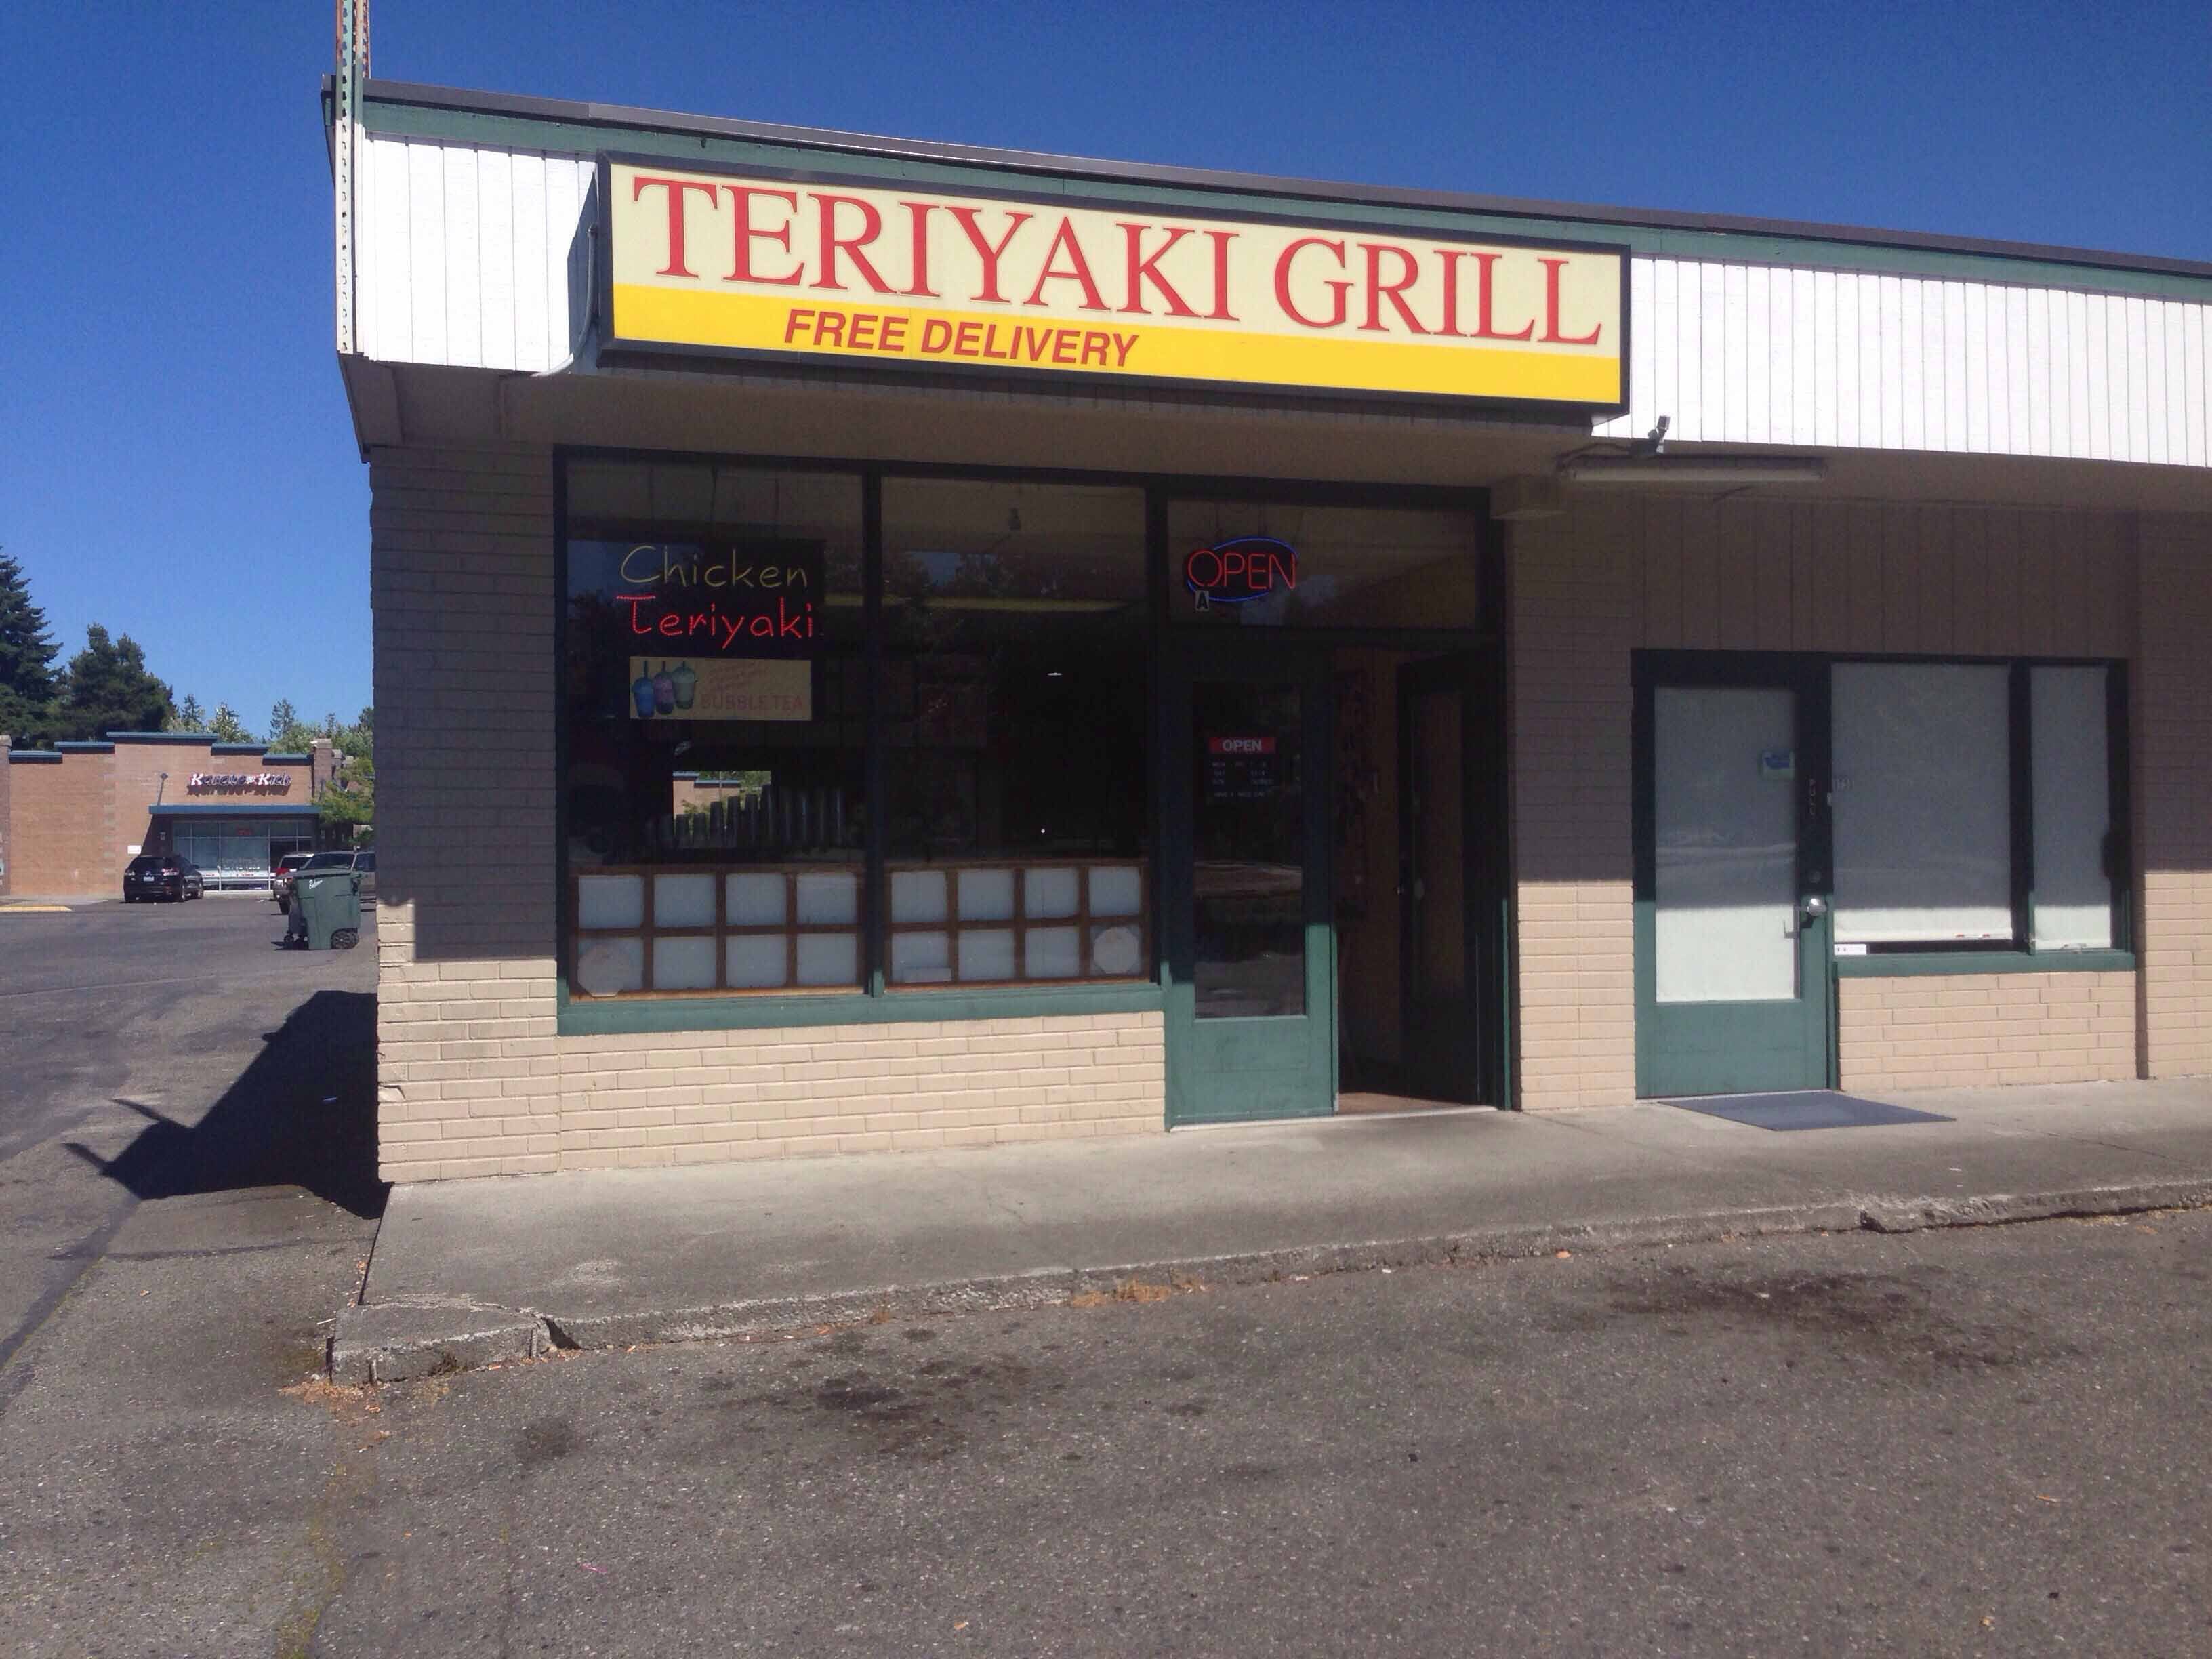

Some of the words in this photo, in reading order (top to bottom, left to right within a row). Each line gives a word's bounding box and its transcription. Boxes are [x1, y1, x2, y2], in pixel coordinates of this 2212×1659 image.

[634, 176, 1240, 321] TERIYAKI
[1274, 237, 1603, 346] GRILL
[784, 308, 909, 352] FREE
[920, 318, 1139, 367] DELIVERY
[619, 544, 808, 588] Chicken
[1187, 550, 1297, 590] OPEN
[1195, 592, 1209, 610] A
[616, 594, 813, 649] Teriyaki
[701, 693, 768, 710] BUBBLE
[771, 694, 804, 711] TEA
[1222, 739, 1263, 752] OPEN
[258, 772, 292, 786] Kids
